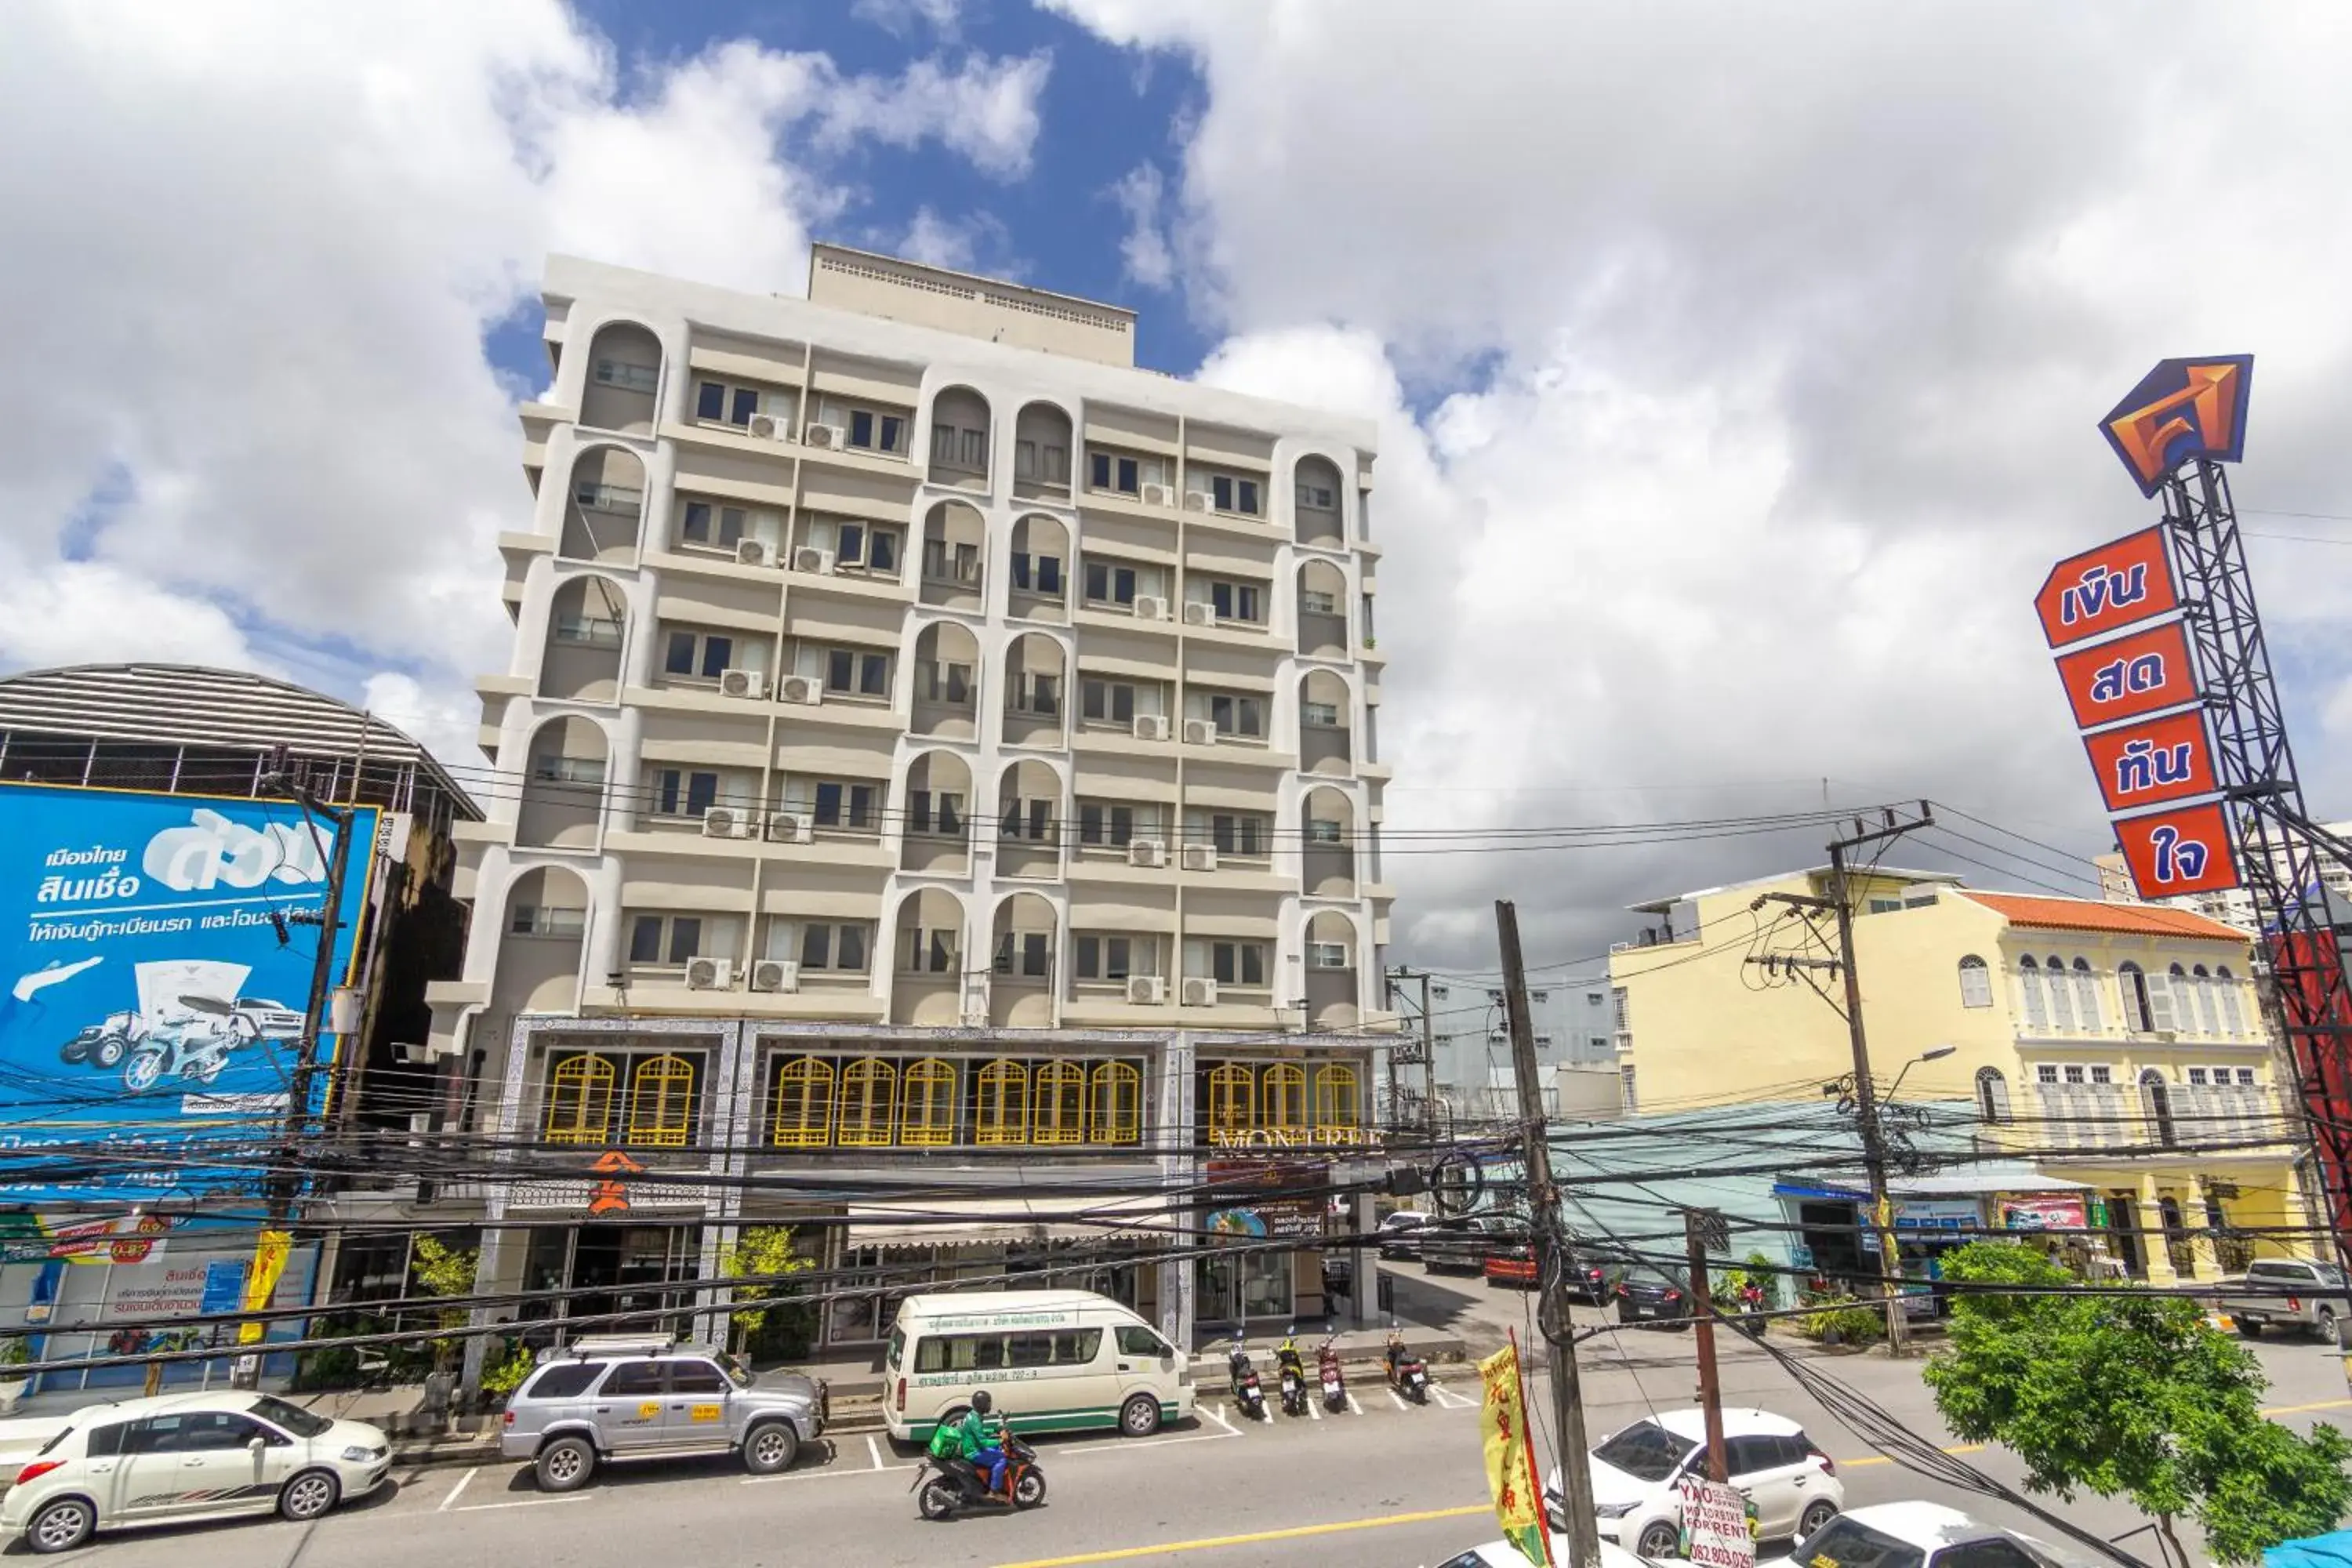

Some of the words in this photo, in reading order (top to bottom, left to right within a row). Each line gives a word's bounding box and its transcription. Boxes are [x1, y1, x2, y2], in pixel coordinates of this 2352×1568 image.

[2061, 562, 2147, 624] เงิน
[2092, 653, 2165, 703] สด
[2117, 740, 2191, 793] ทัน
[45, 845, 127, 866] เมืองไทย
[2151, 825, 2208, 882] ใจ
[38, 866, 140, 902] สินเชื่อ
[1680, 1484, 1713, 1504] YAO
[1712, 1522, 1748, 1539] RENT
